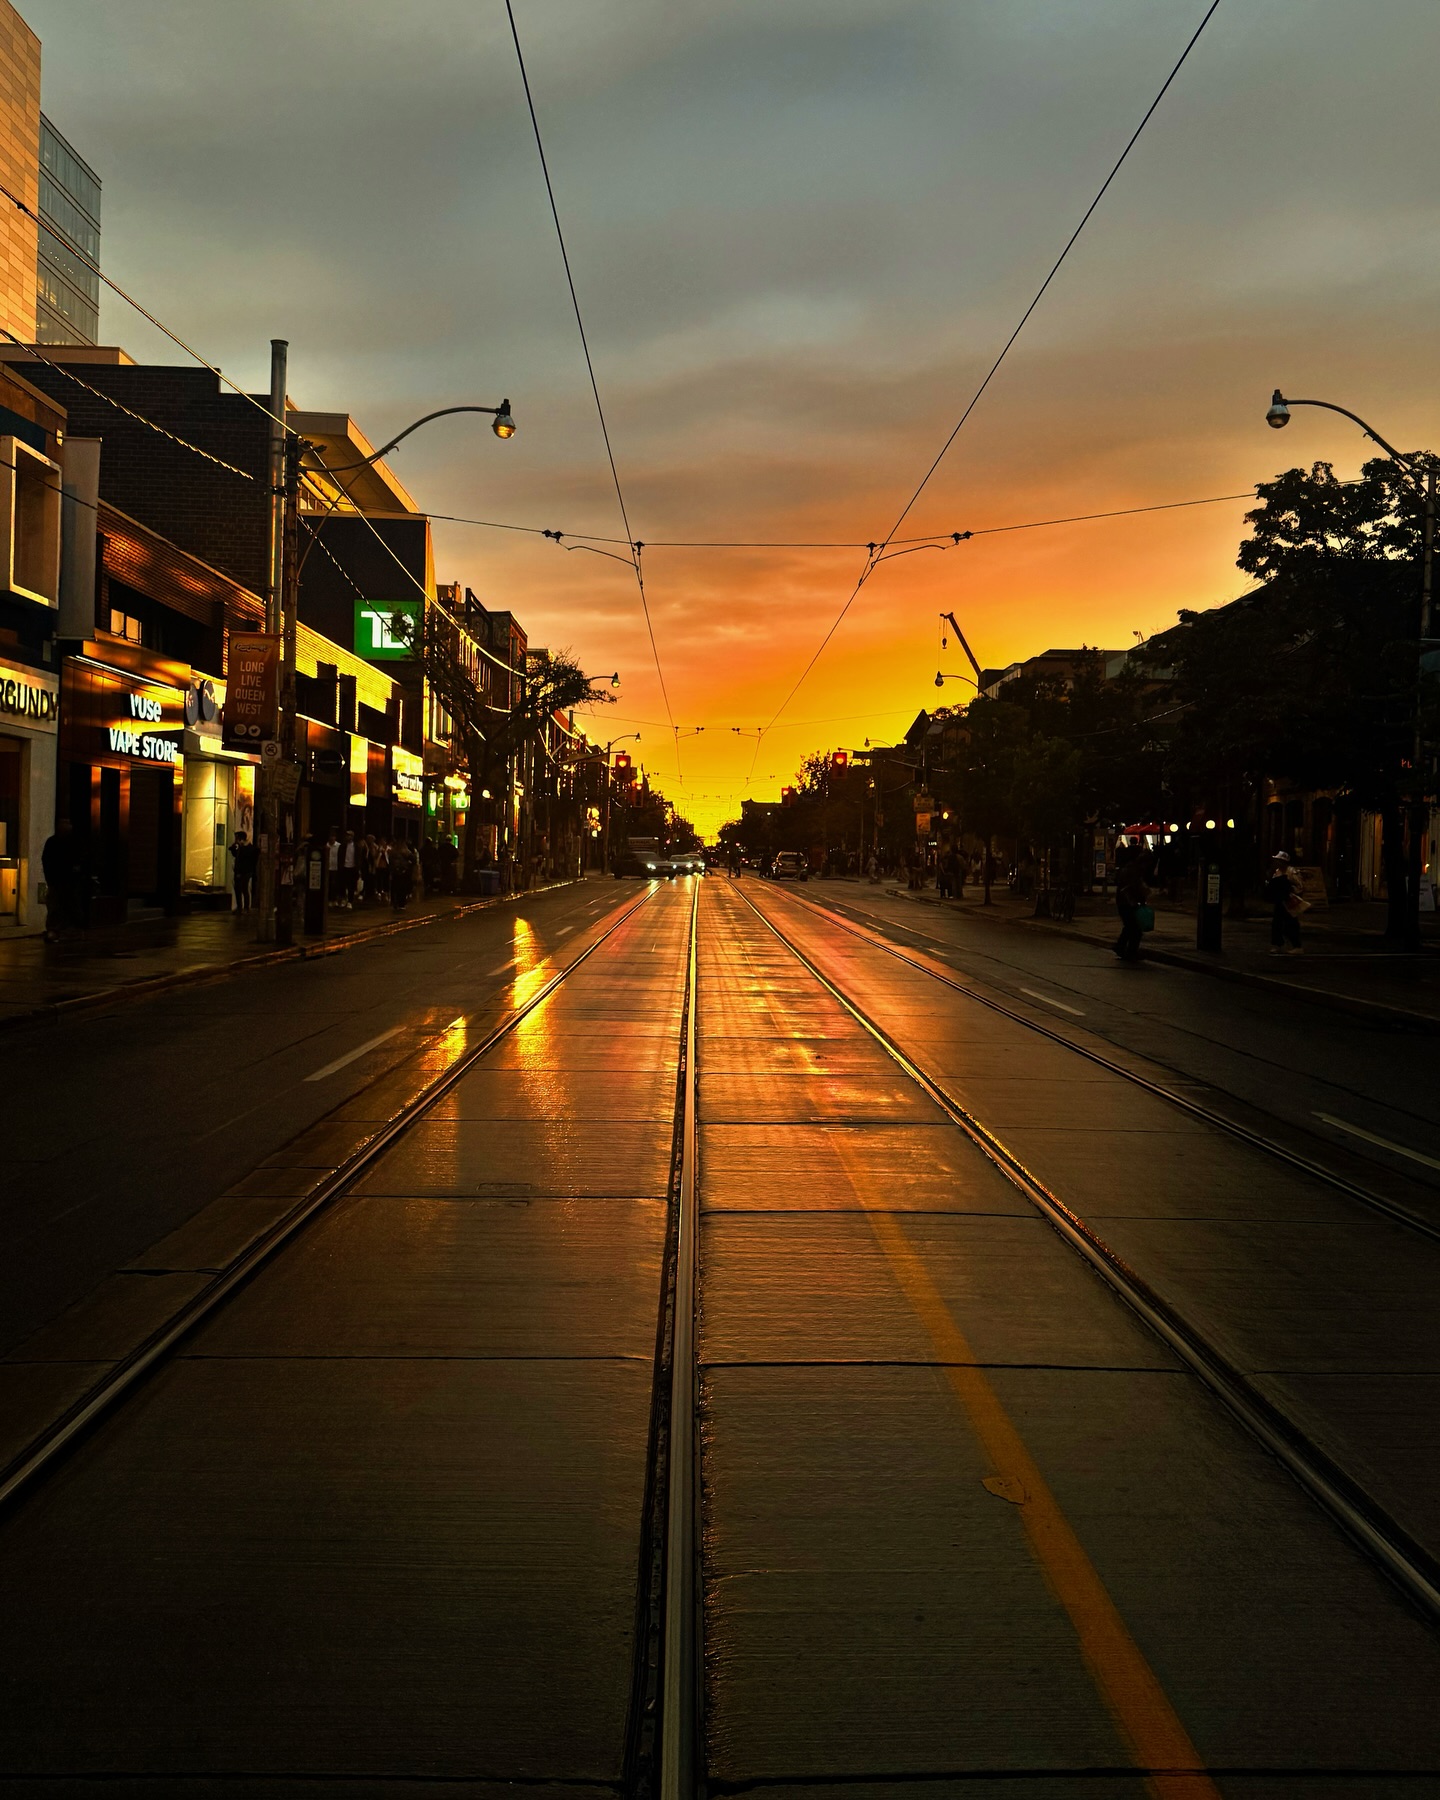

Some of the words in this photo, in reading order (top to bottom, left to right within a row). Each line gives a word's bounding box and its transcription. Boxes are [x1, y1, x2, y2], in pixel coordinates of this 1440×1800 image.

[361, 611, 415, 649] TD
[240, 661, 265, 673] LONG
[241, 674, 262, 687] LIVE
[235, 688, 266, 702] QUEEN
[236, 702, 263, 715] WEST
[109, 728, 140, 756] VAPE
[142, 735, 179, 763] STORE
